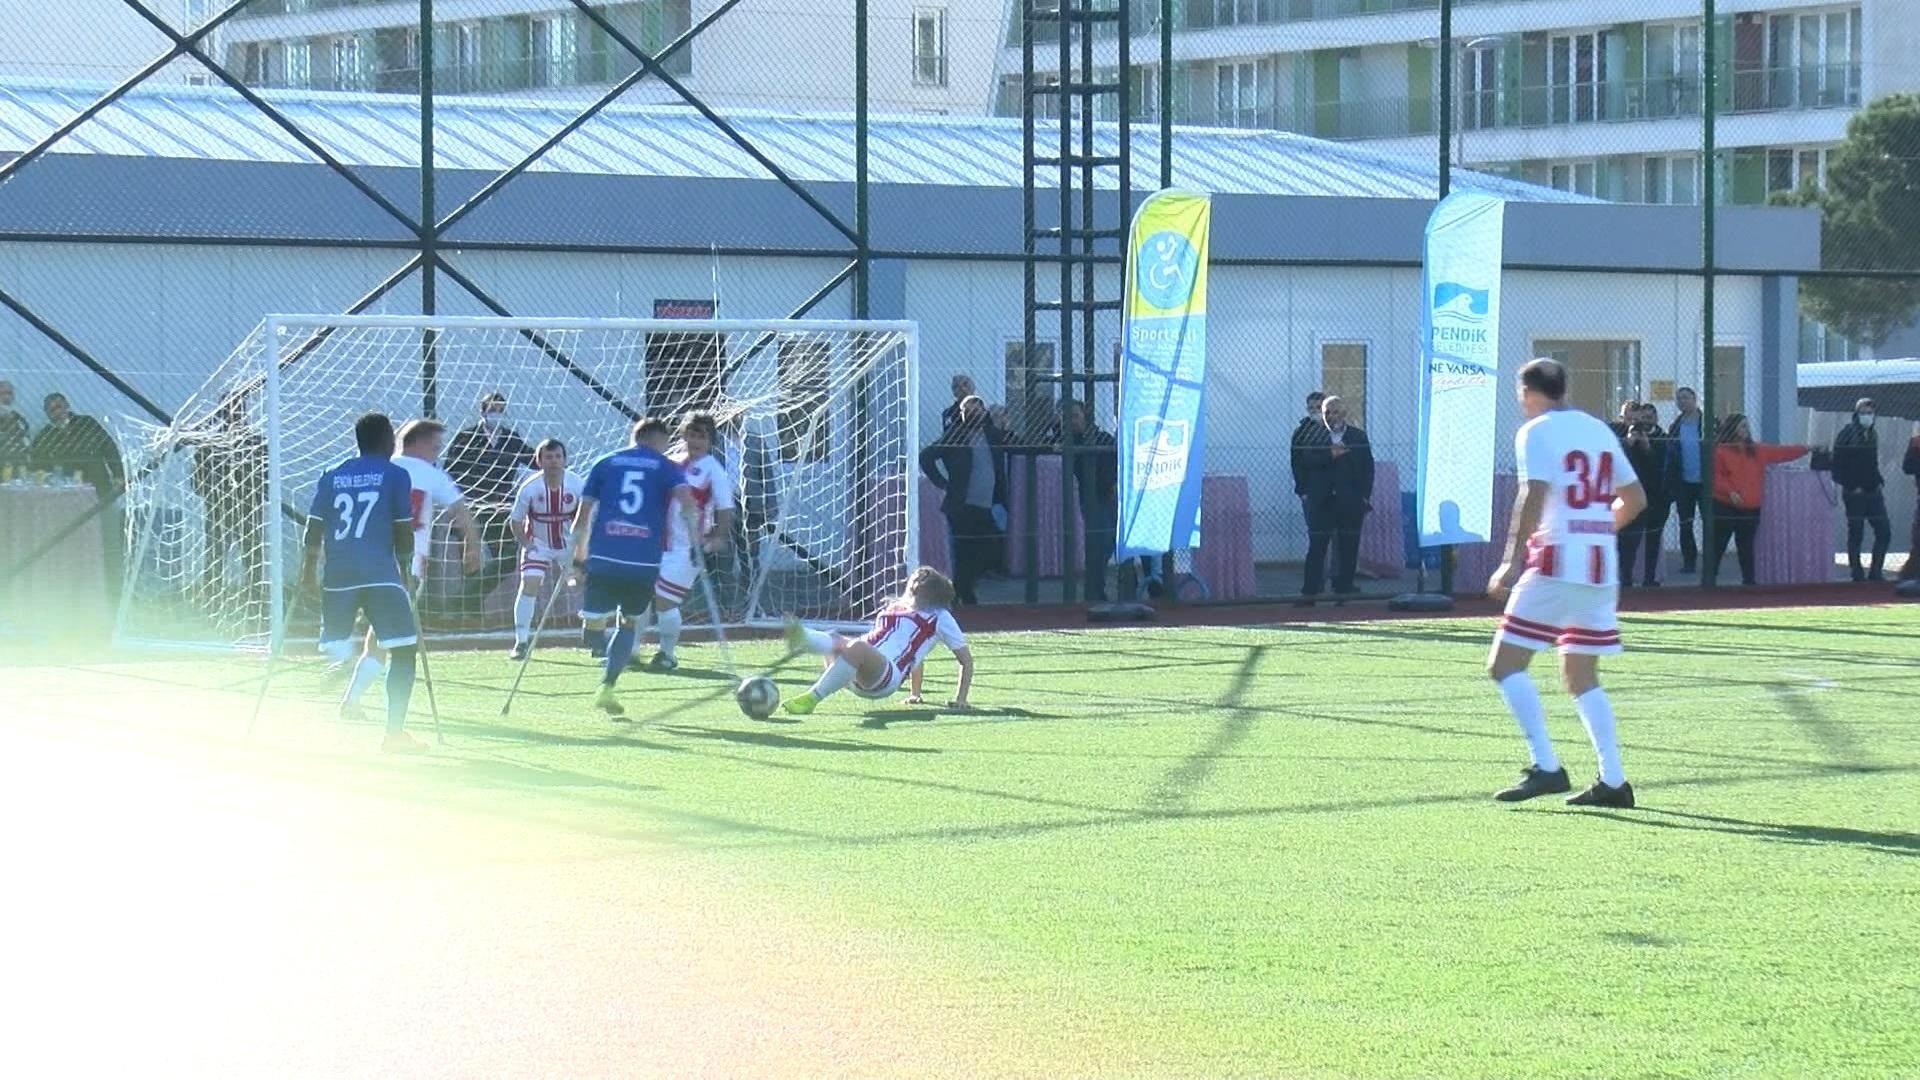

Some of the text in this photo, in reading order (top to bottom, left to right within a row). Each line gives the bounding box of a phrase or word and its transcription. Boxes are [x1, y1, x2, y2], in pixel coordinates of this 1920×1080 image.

[1429, 363, 1486, 376] NE VARSA
[619, 471, 645, 514] 5
[1563, 450, 1617, 511] 34
[334, 491, 380, 540] 37
